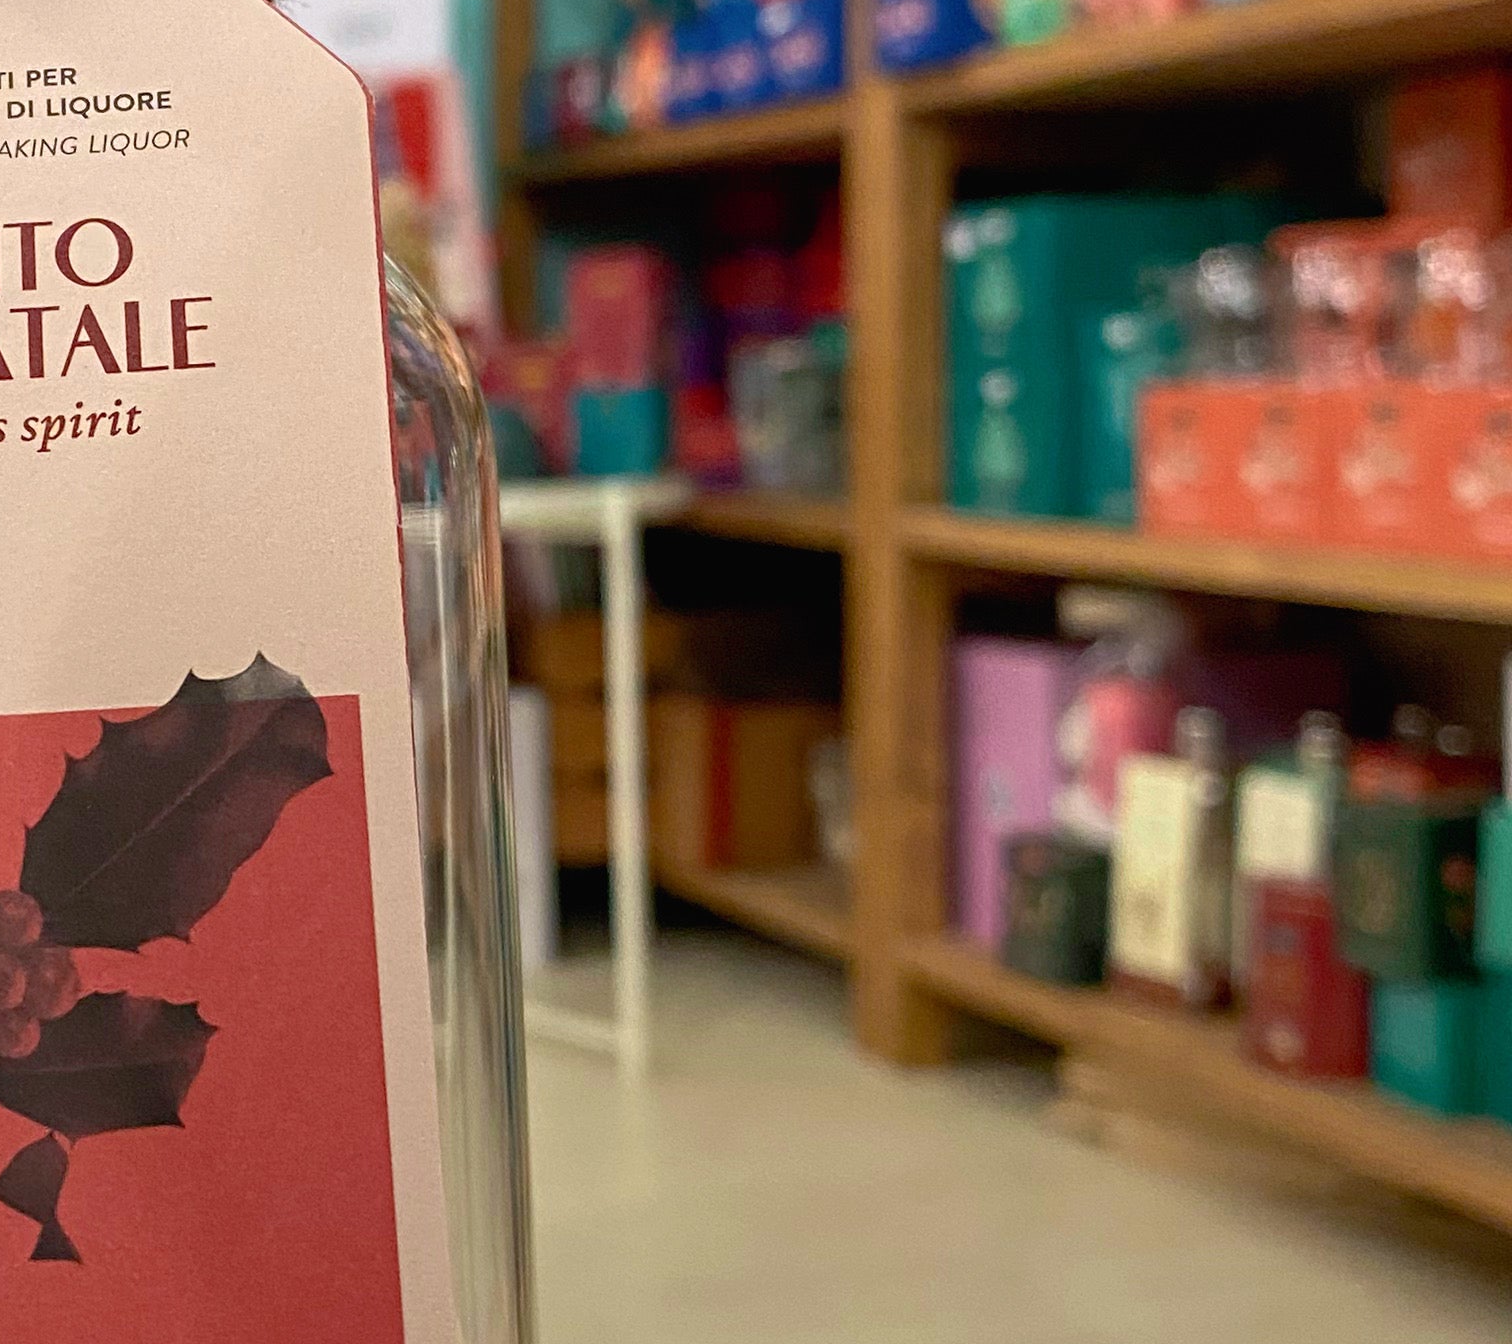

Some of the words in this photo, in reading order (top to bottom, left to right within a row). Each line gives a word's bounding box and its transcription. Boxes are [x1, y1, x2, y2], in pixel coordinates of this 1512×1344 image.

[26, 67, 77, 88] PER
[7, 99, 34, 120] DI
[46, 90, 172, 120] LIQUORE
[89, 128, 190, 157] LIQUOR
[20, 398, 142, 453] spirit
